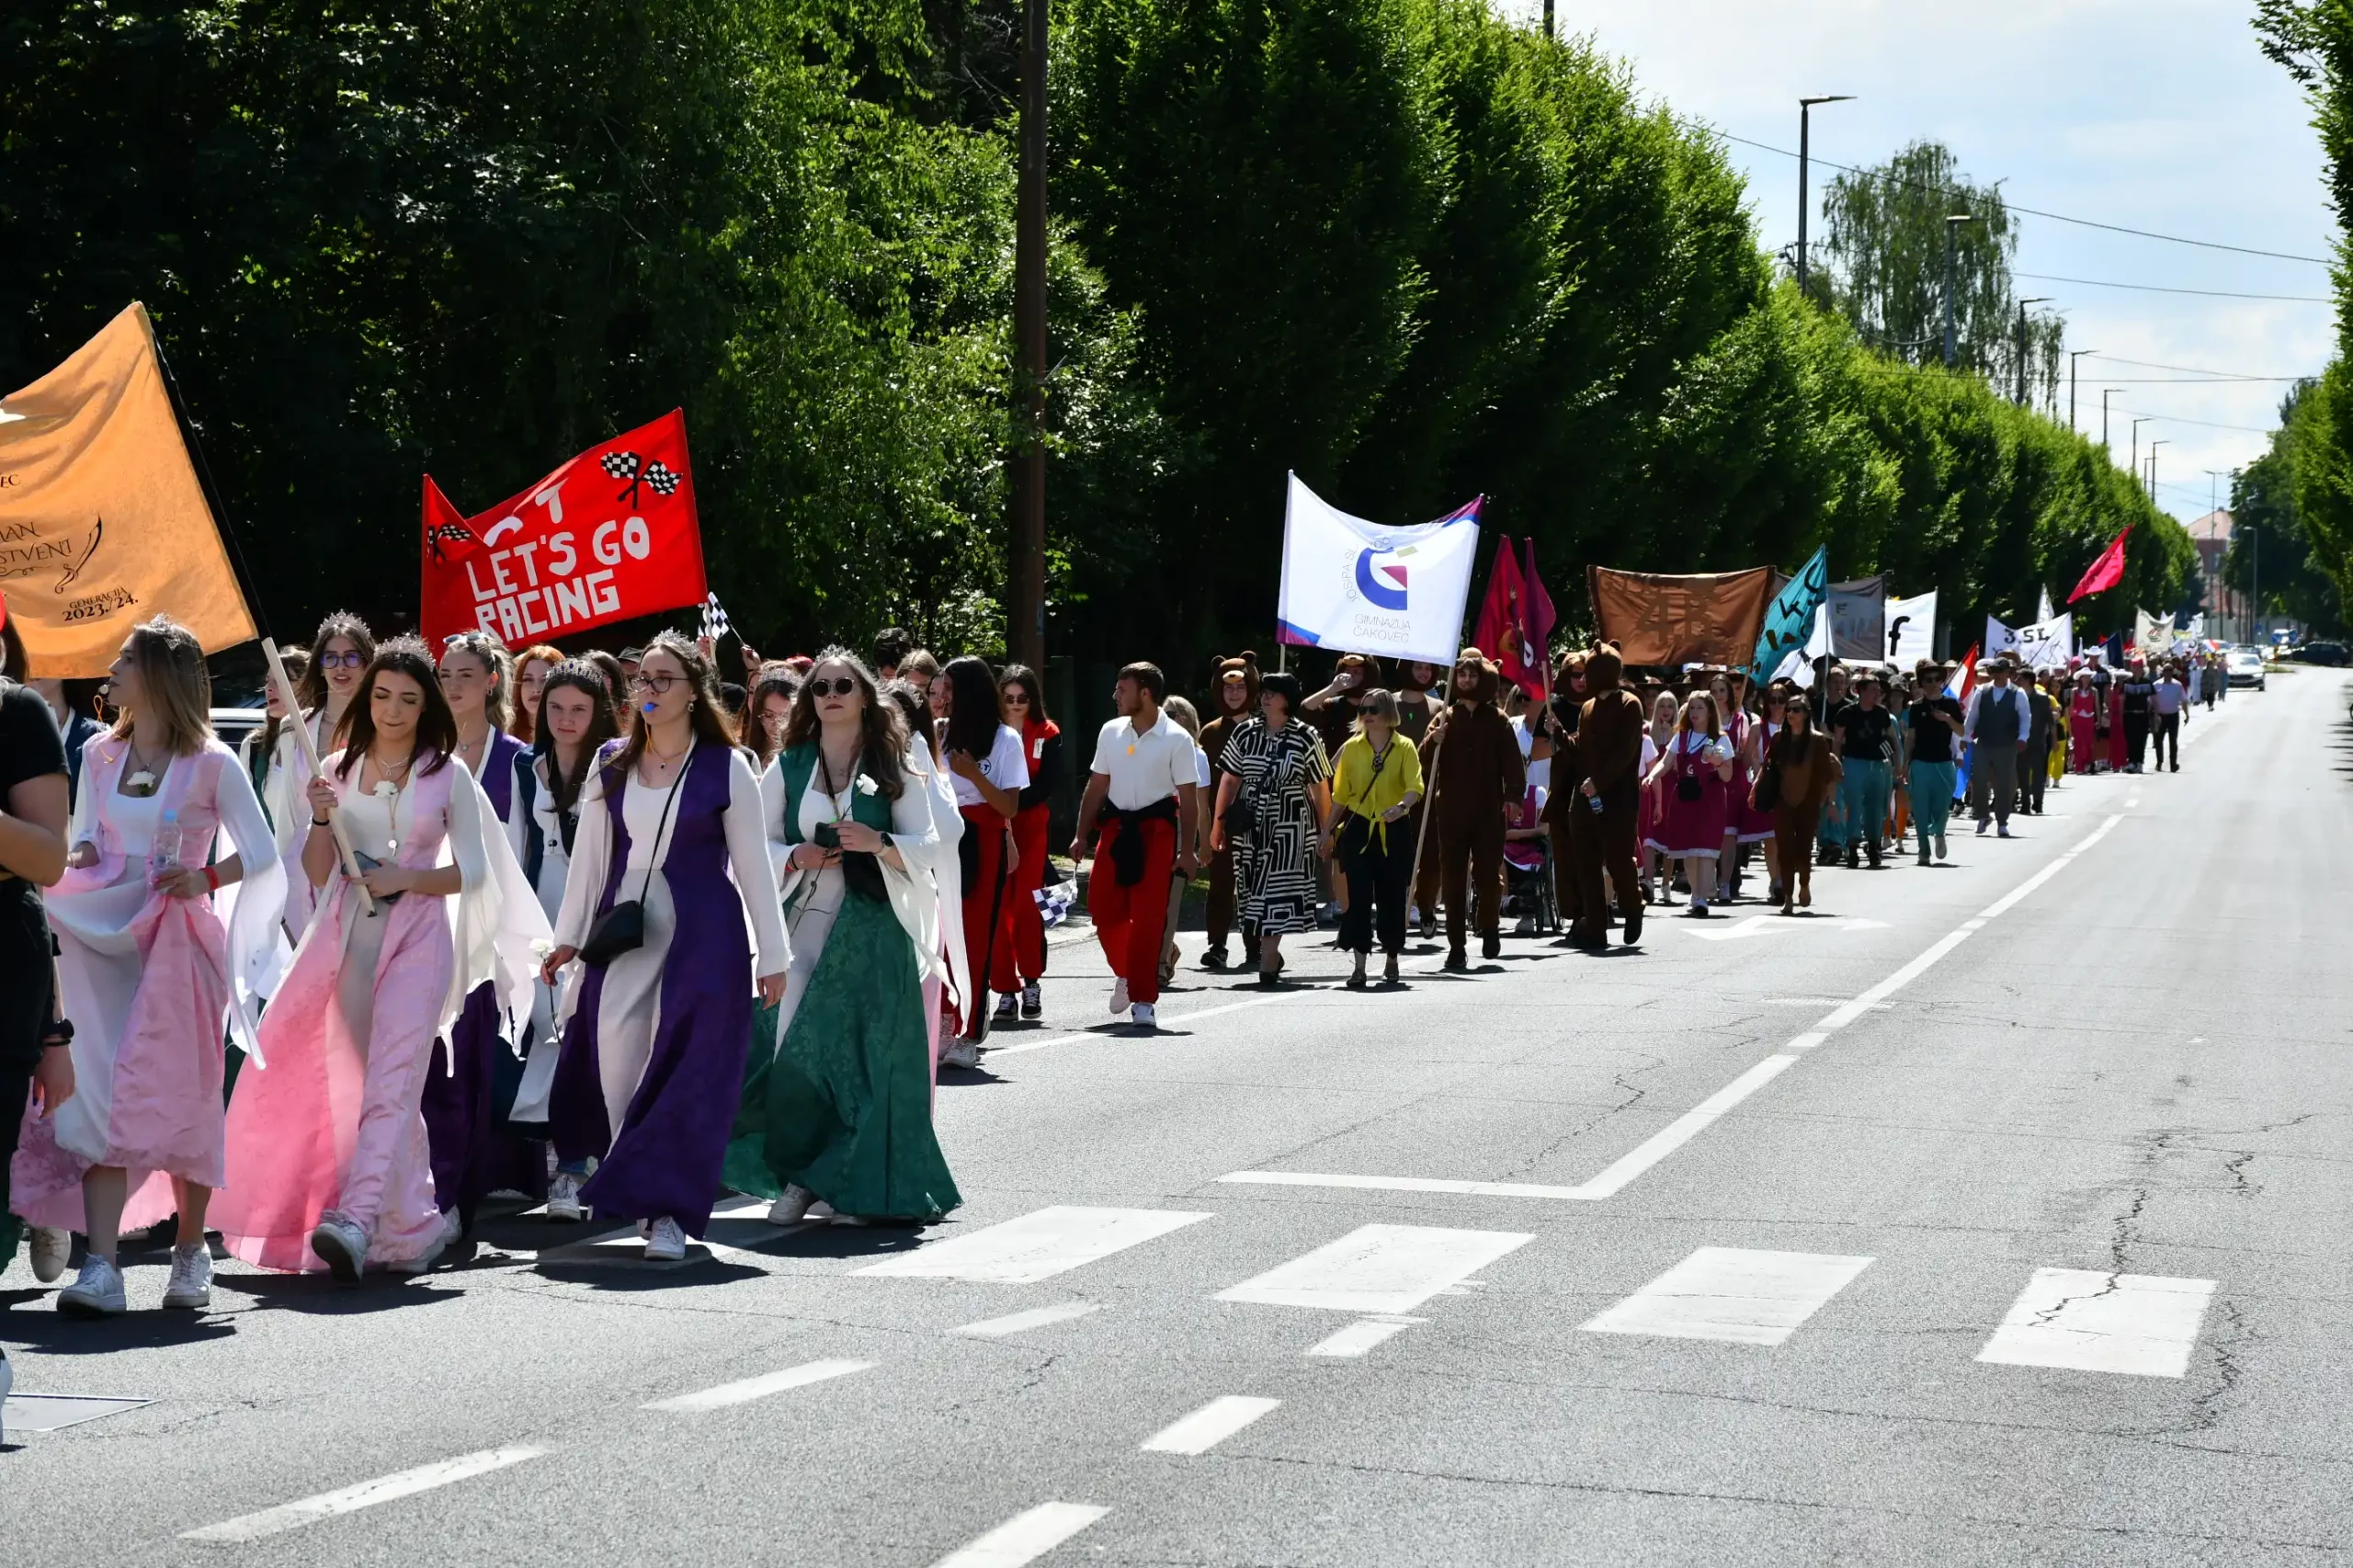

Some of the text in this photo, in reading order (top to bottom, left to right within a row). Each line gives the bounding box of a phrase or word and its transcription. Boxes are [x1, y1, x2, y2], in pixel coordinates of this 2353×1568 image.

[466, 516, 650, 603] LET'S GO
[474, 569, 621, 642] RACING
[1355, 613, 1411, 631] GIMNAZIJA
[1353, 624, 1409, 643] ČAKOVEC
